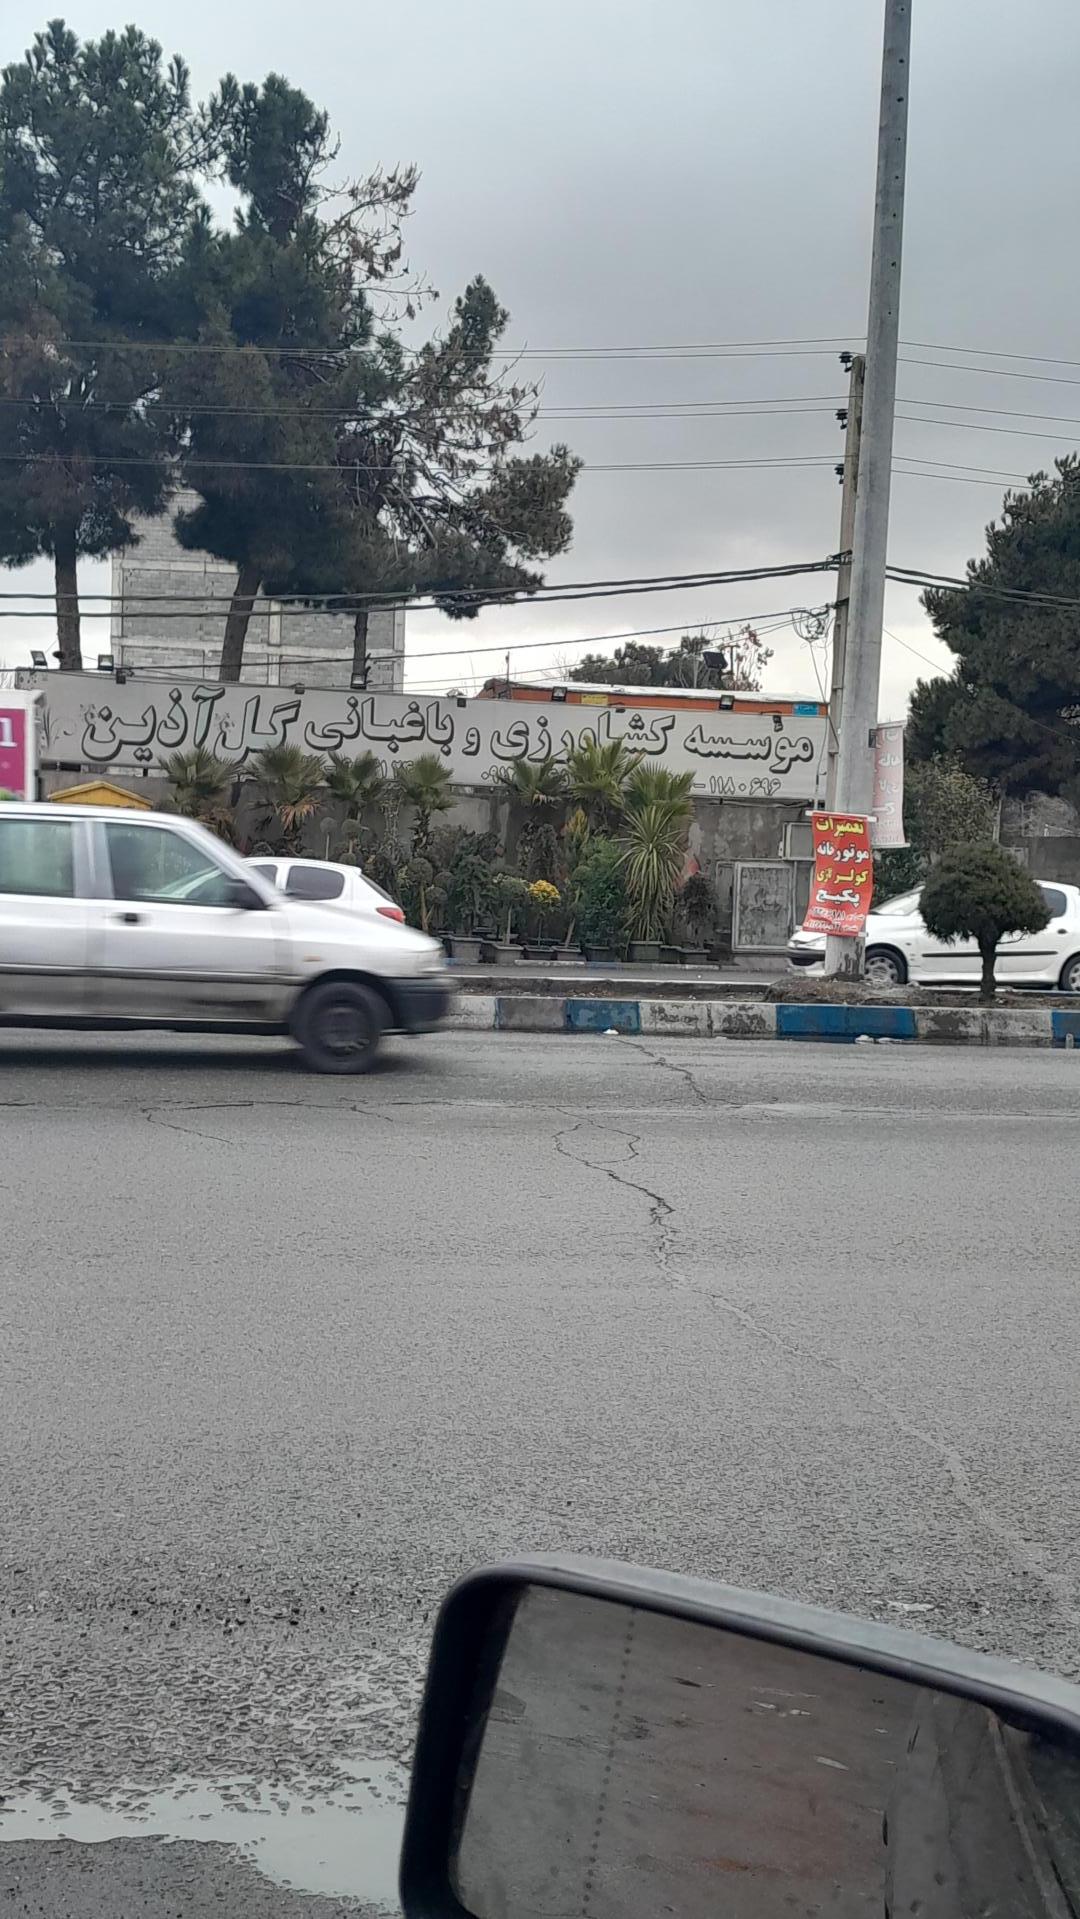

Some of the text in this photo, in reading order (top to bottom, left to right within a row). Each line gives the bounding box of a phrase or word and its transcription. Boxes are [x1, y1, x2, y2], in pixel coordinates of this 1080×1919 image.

[81, 685, 226, 761] آذین
[213, 696, 302, 764] گل
[304, 696, 455, 756] باغبانی
[463, 726, 480, 756] و
[490, 710, 676, 762] کشاورزی
[815, 816, 864, 836] تعمیرات
[833, 868, 869, 886] کولر
[815, 888, 860, 908] پکیج
